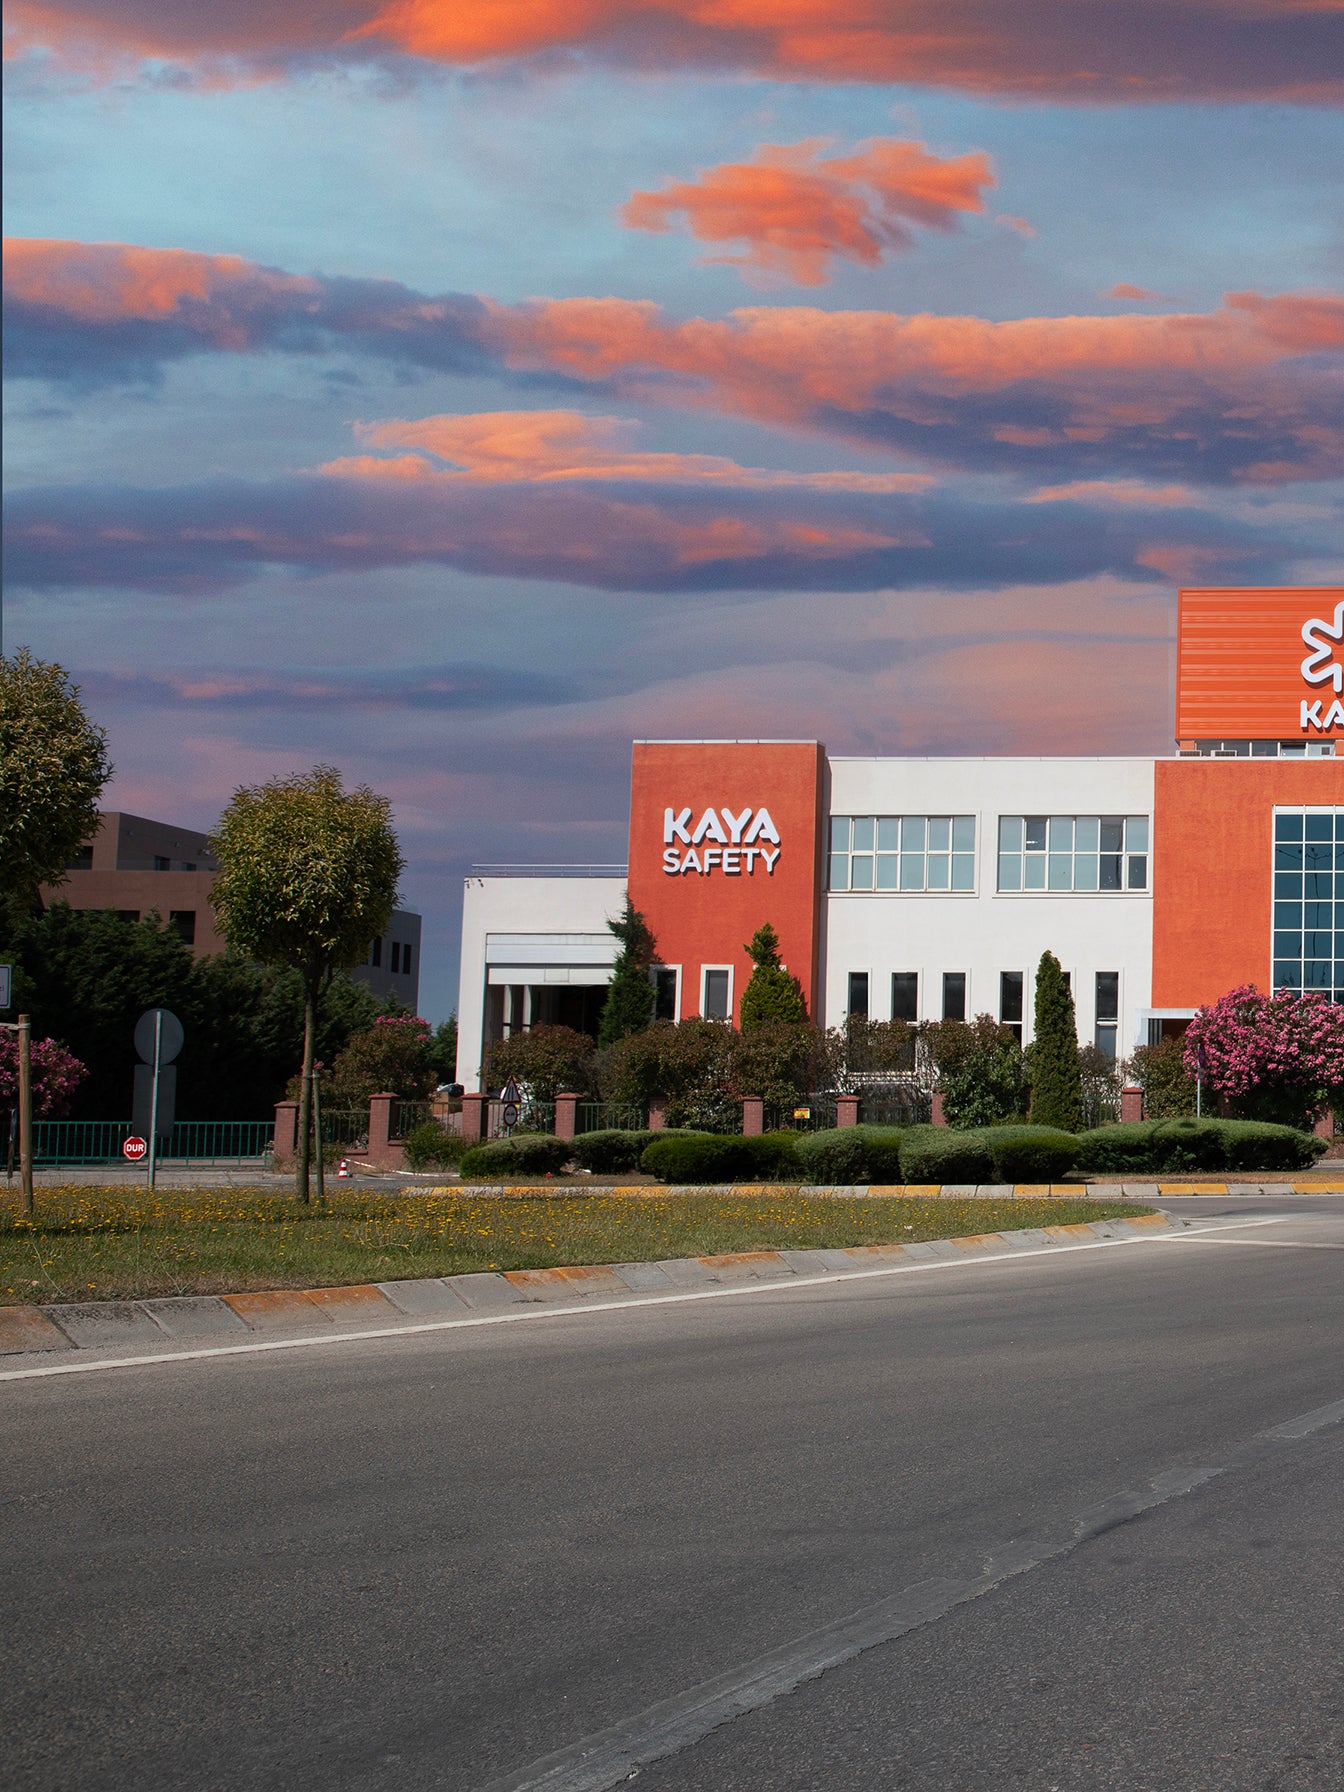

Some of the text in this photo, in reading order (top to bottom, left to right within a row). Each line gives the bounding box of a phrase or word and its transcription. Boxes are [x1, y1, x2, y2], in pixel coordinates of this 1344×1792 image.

[663, 807, 780, 844] KAYA
[662, 848, 781, 873] SAFETY
[126, 1143, 145, 1152] DUR
